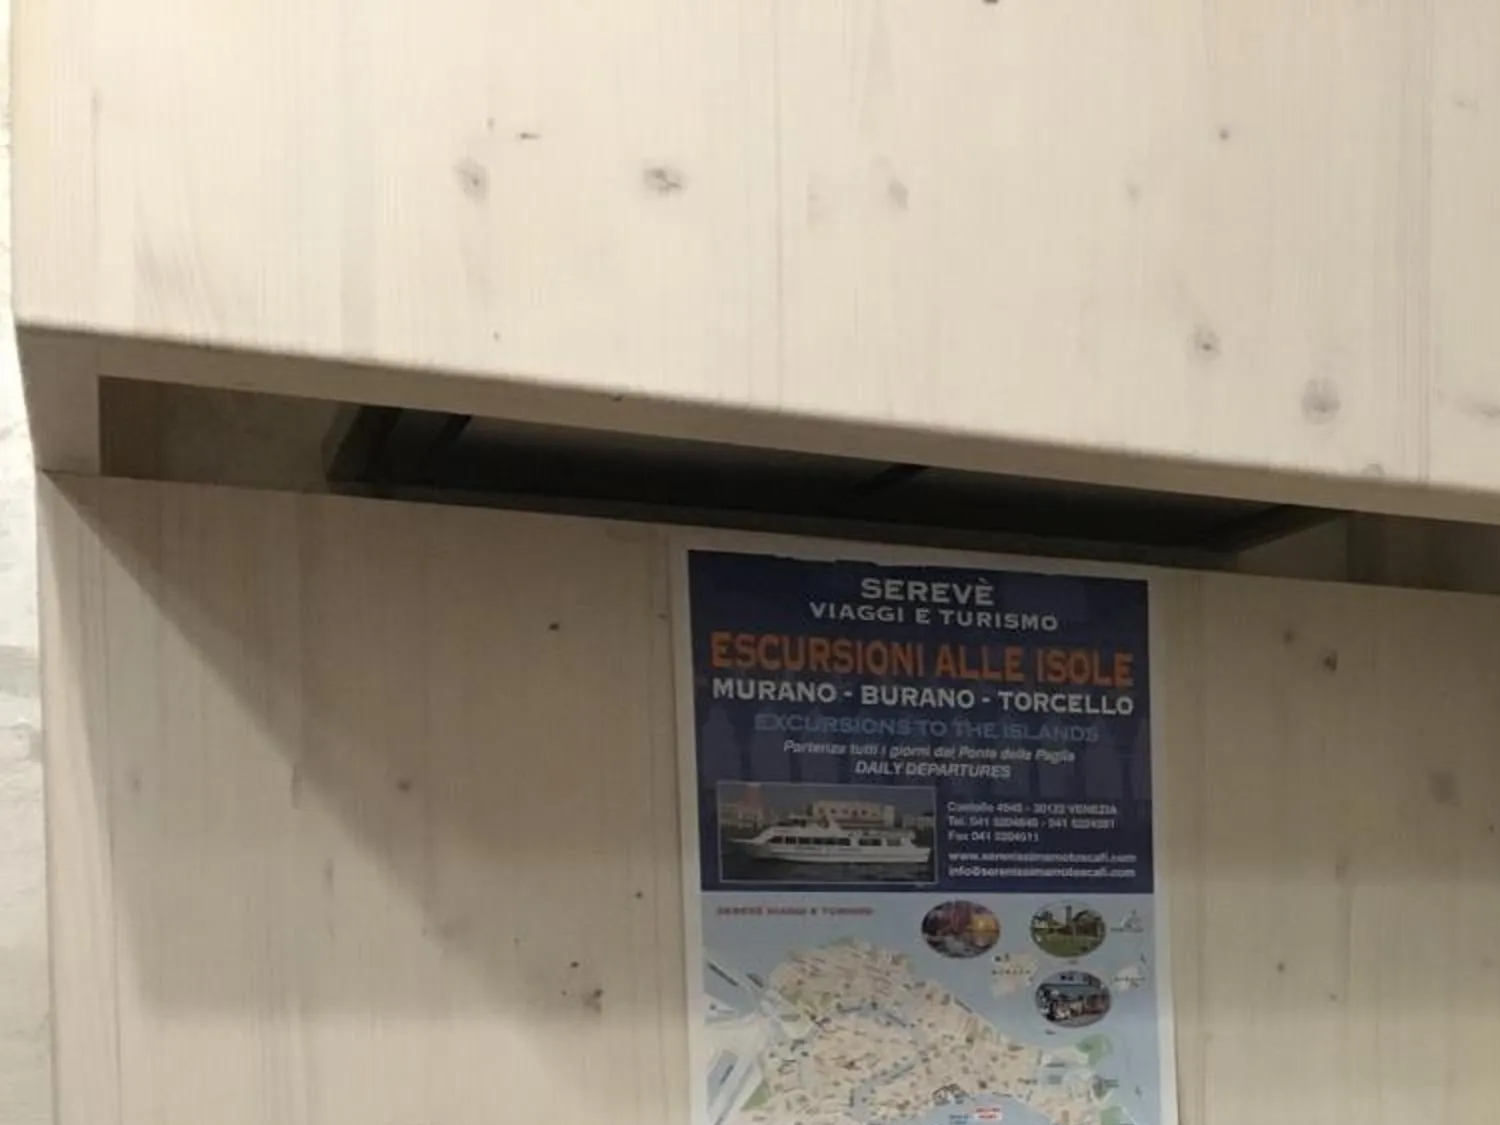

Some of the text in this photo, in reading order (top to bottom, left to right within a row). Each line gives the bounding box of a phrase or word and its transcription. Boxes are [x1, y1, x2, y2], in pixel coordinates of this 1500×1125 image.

[860, 577, 994, 606] SEREVÈ
[809, 601, 1059, 631] VIAGGI E TURISMO
[710, 630, 1135, 688] ESCURSIONI ALLE ISOLE
[711, 677, 837, 703] MURANO
[860, 684, 975, 708] BURANO
[997, 690, 1134, 715] TORCELLO
[753, 712, 1100, 743] EXCURSIONS TO THE ISLANDS
[889, 744, 931, 760] giorni
[855, 759, 1012, 779] DAILY DEPARTURES
